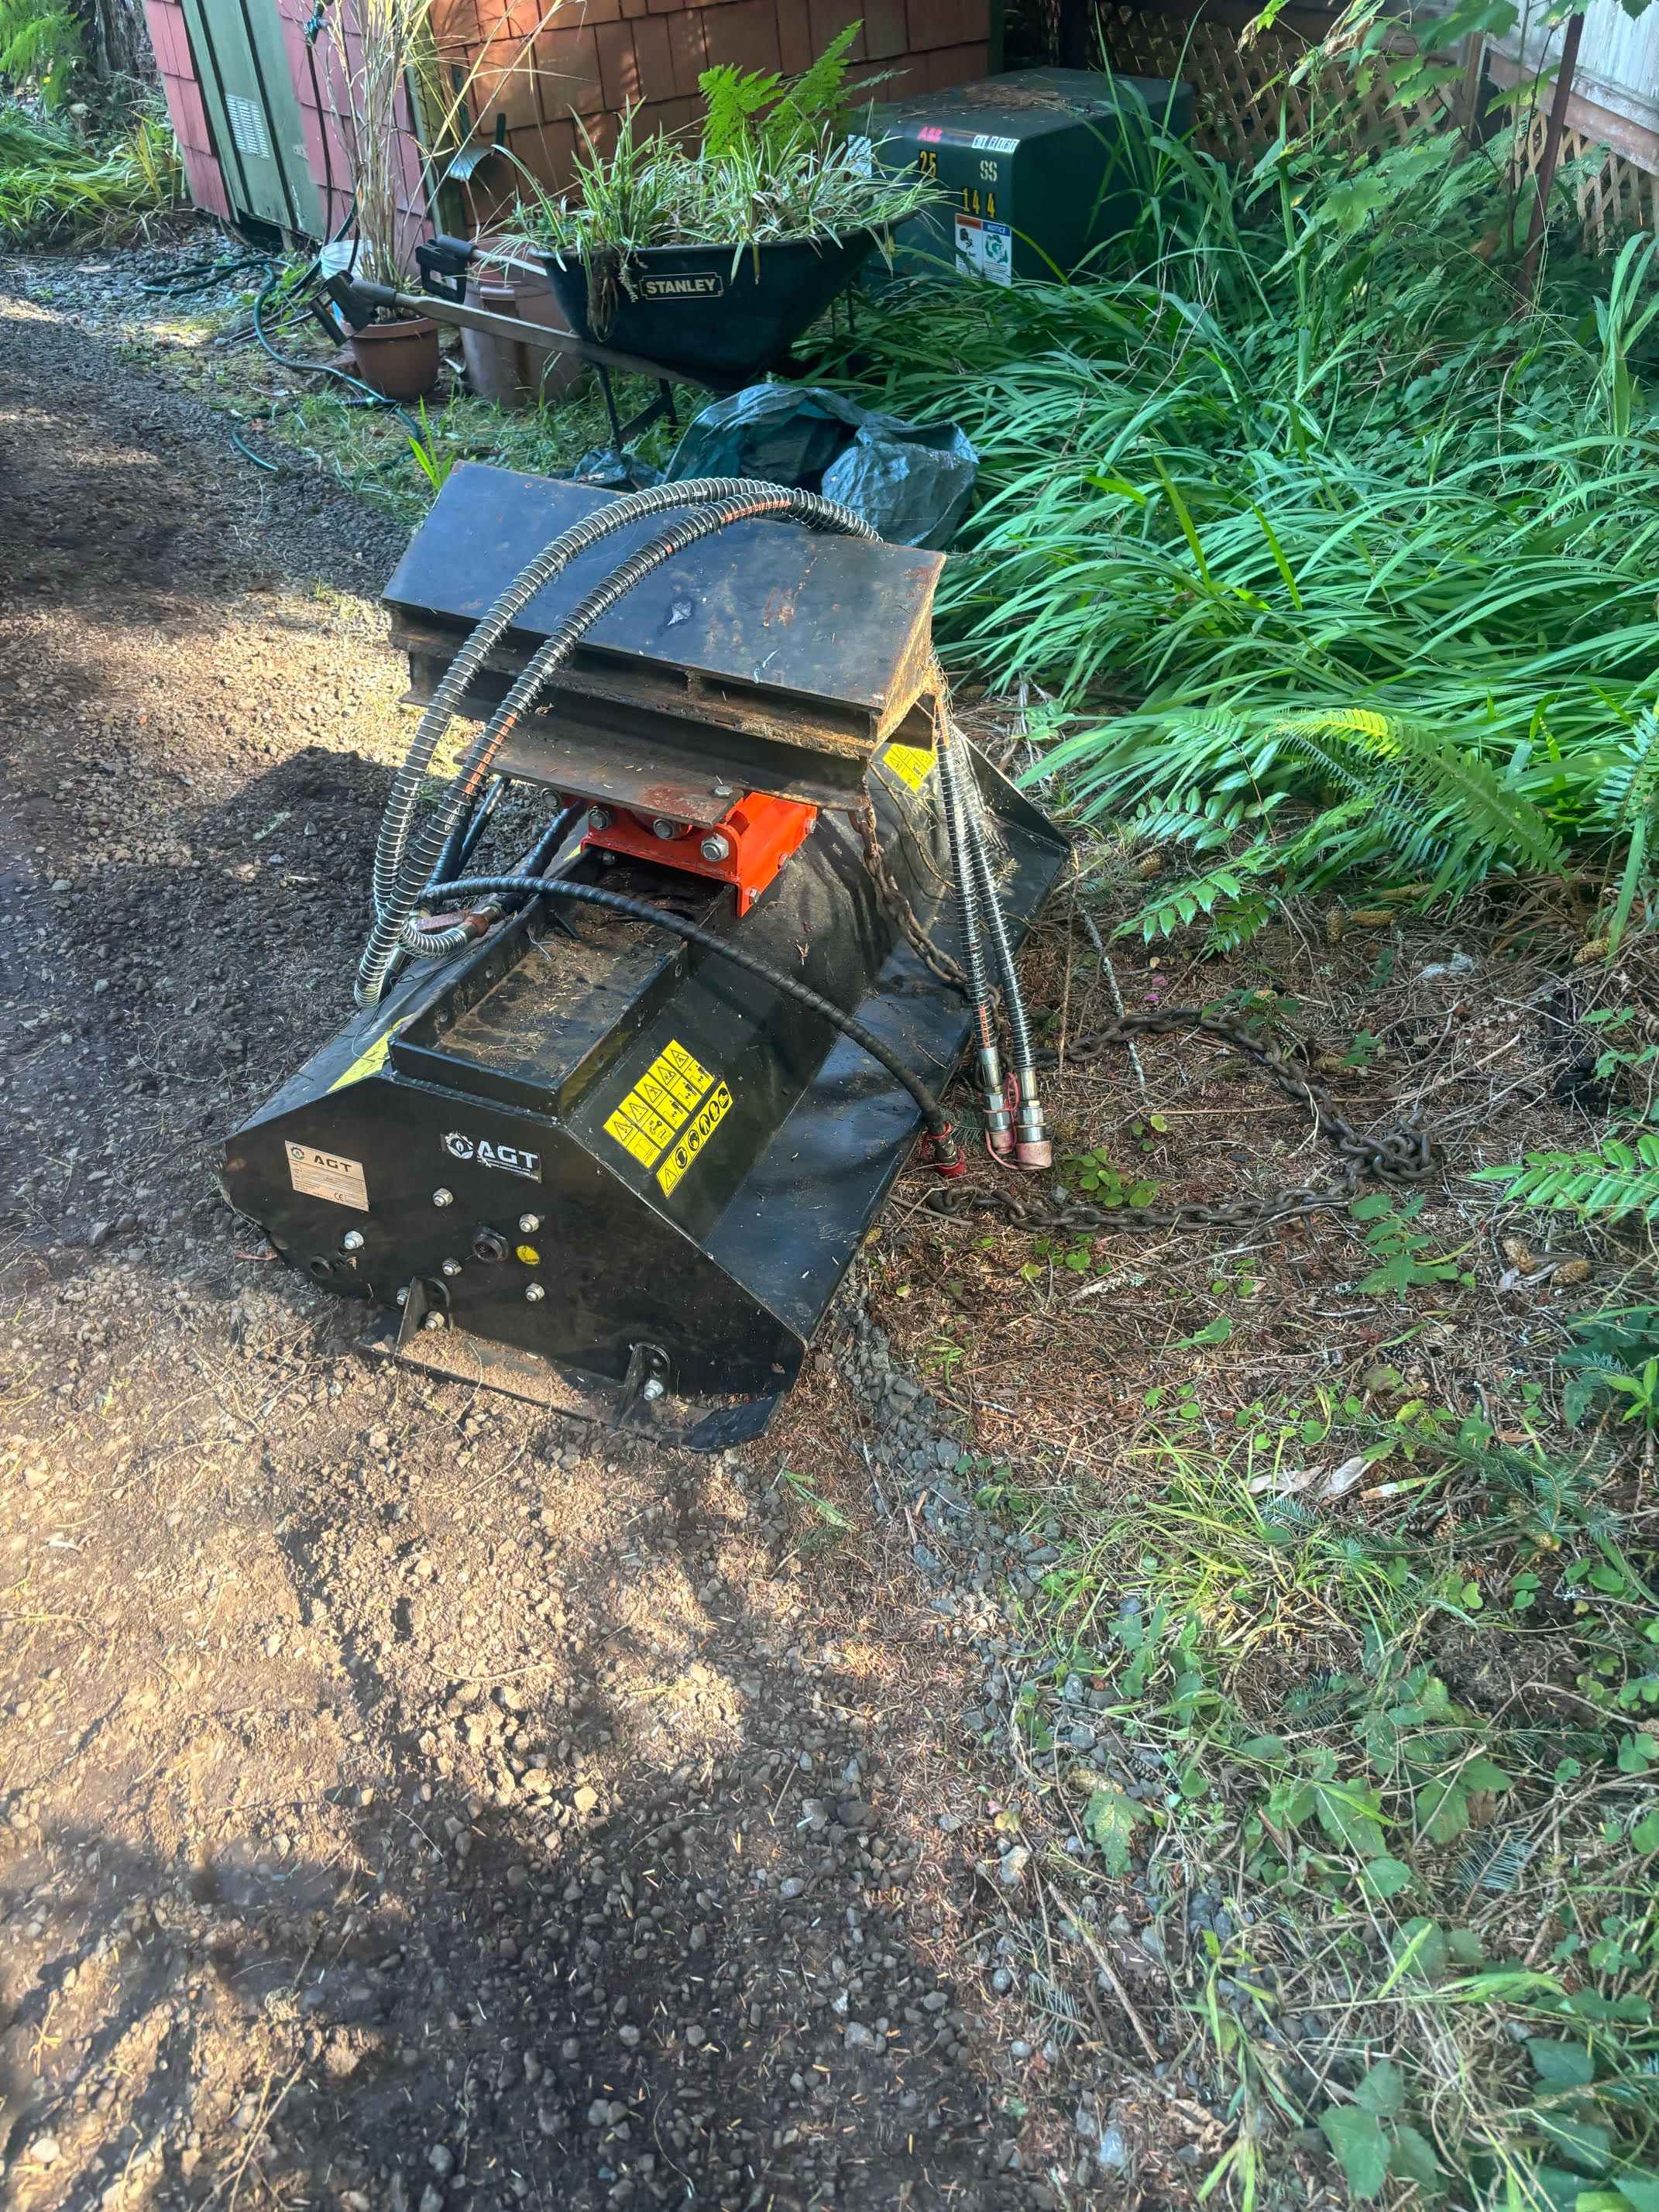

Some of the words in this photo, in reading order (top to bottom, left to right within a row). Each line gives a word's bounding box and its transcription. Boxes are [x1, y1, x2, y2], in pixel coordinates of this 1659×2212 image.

[979, 160, 998, 182] SS
[645, 278, 716, 294] STANLEY
[314, 1155, 352, 1173] AGT
[478, 1140, 539, 1169] AGT
